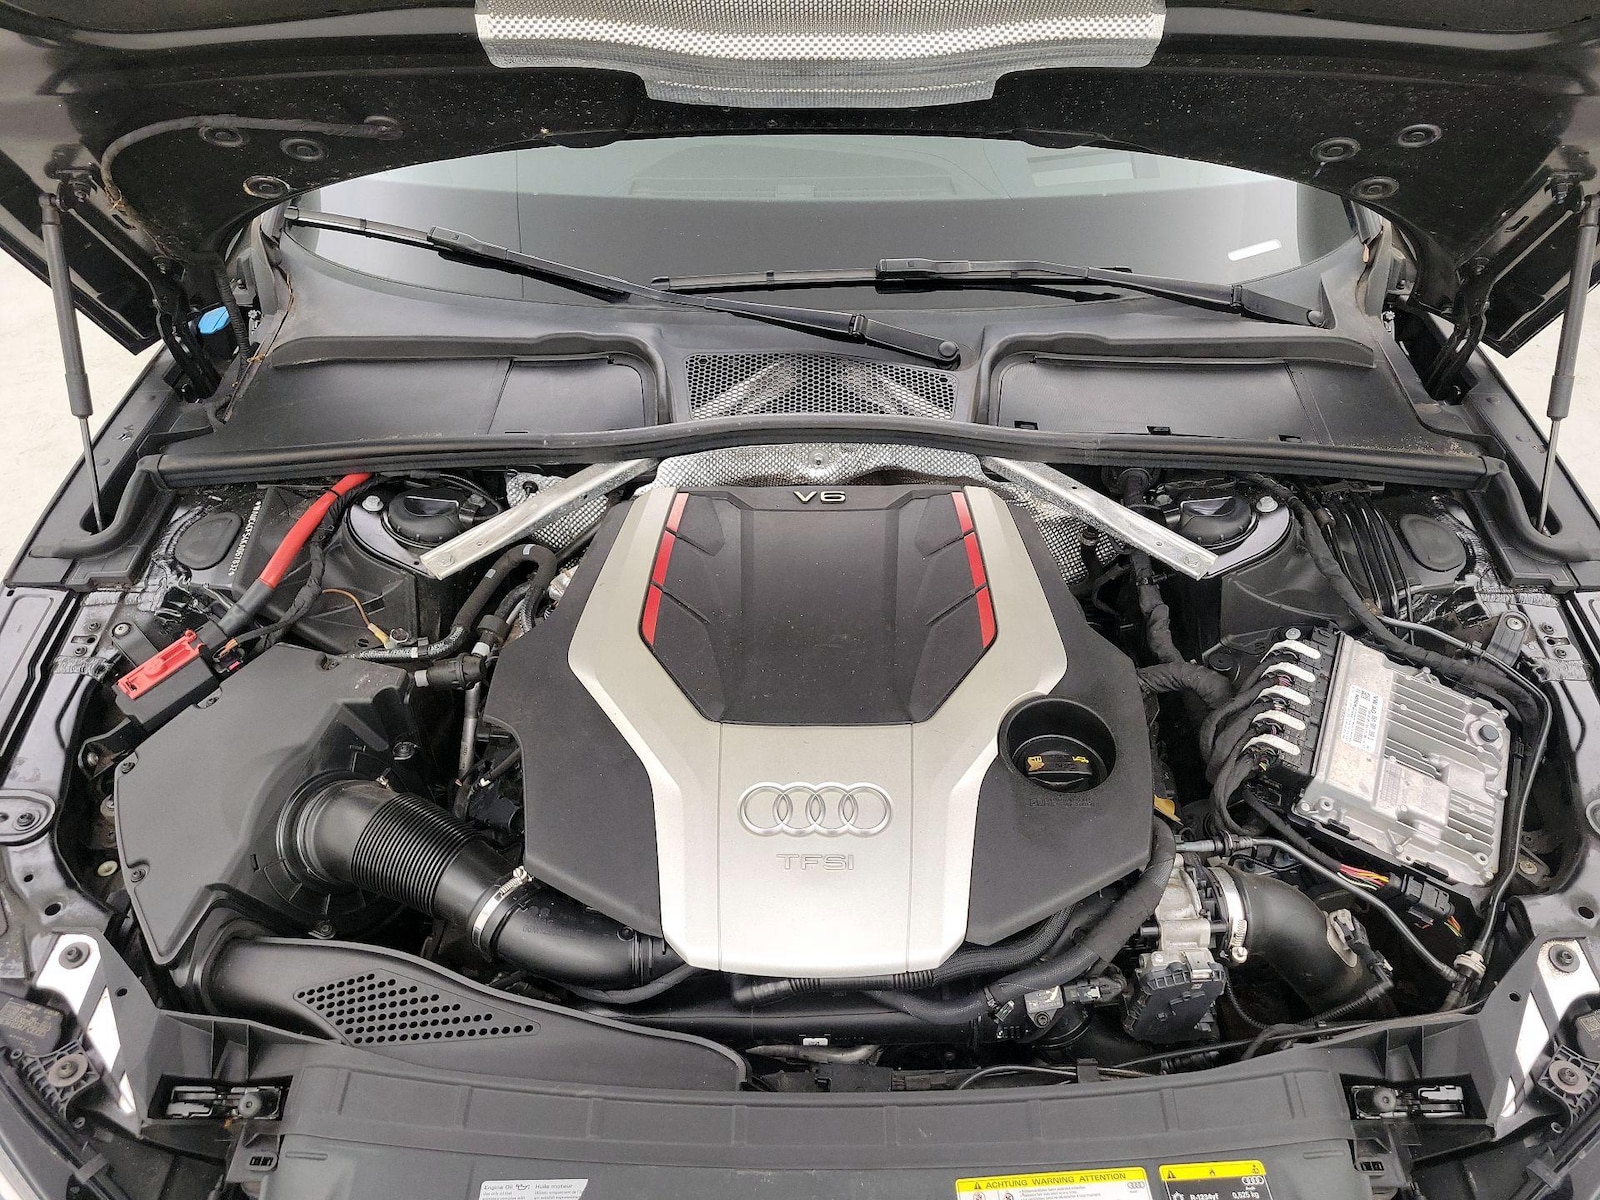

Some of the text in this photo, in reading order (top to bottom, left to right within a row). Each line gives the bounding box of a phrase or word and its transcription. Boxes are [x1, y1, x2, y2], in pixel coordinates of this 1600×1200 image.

[793, 490, 846, 504] V6
[776, 853, 855, 871] TFSI
[985, 1172, 1127, 1189] ACHTUNG WARNING ATTENTION
